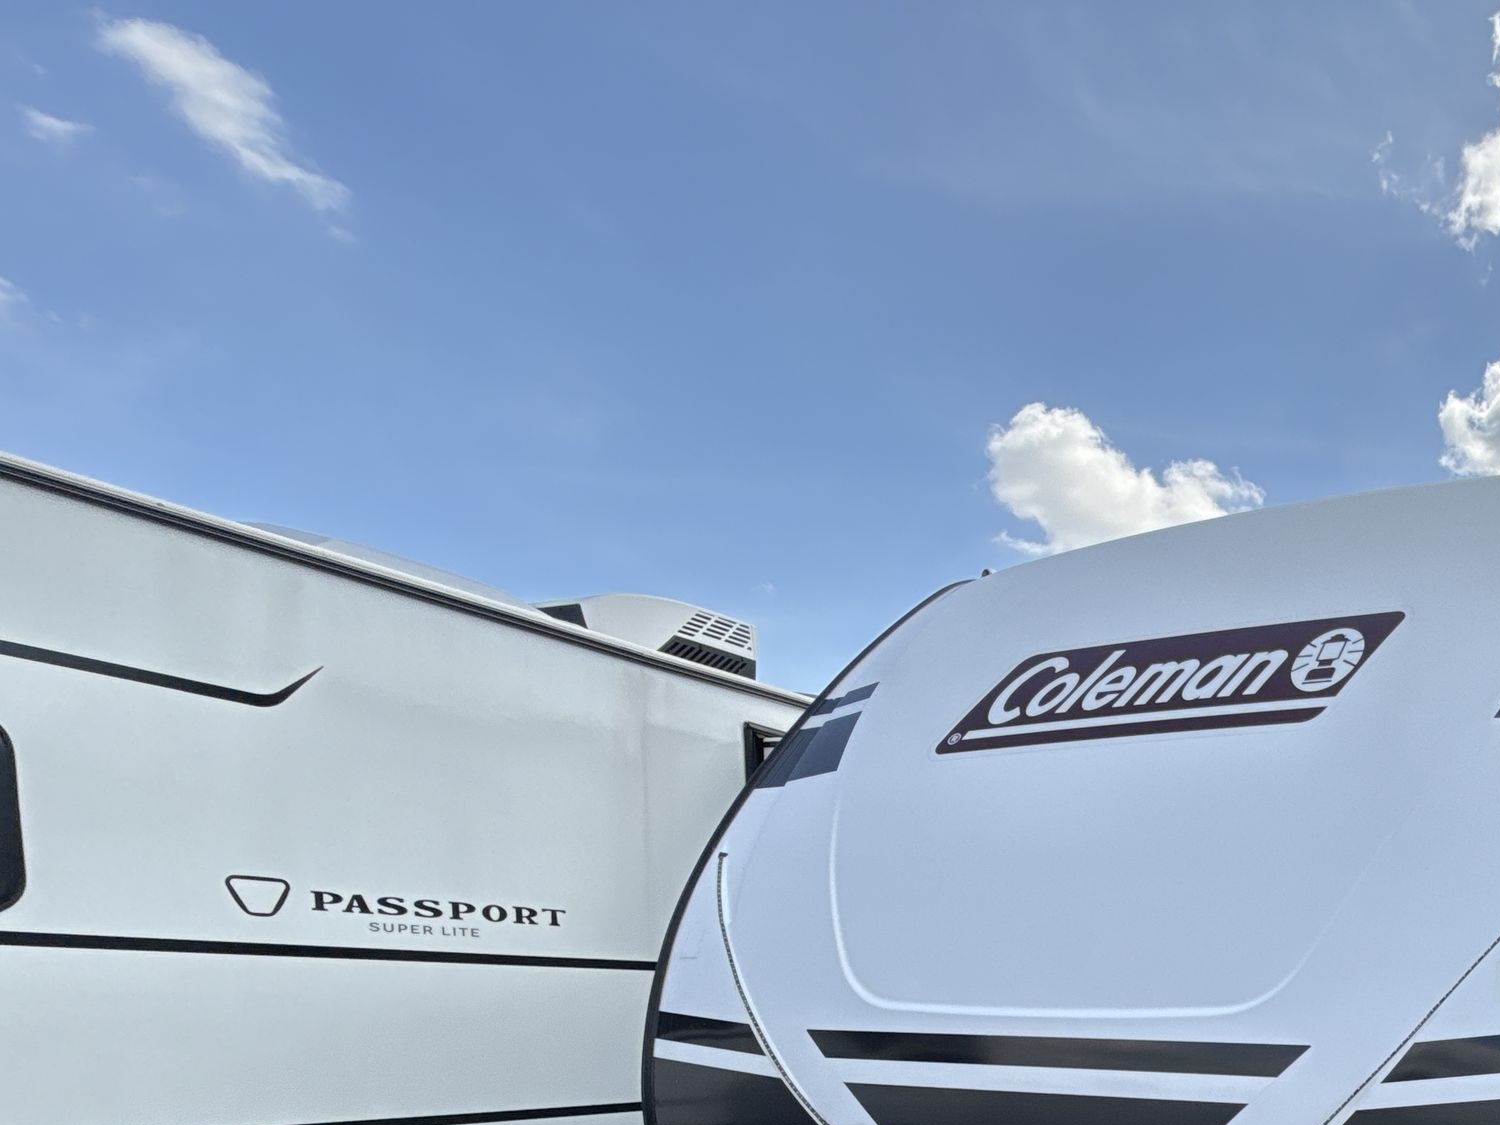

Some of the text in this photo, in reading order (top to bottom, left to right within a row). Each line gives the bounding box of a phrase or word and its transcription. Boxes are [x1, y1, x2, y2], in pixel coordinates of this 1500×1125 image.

[988, 649, 1288, 725] Coleman
[310, 890, 566, 926] PASSPORT
[369, 922, 480, 938] SUPER LITE
